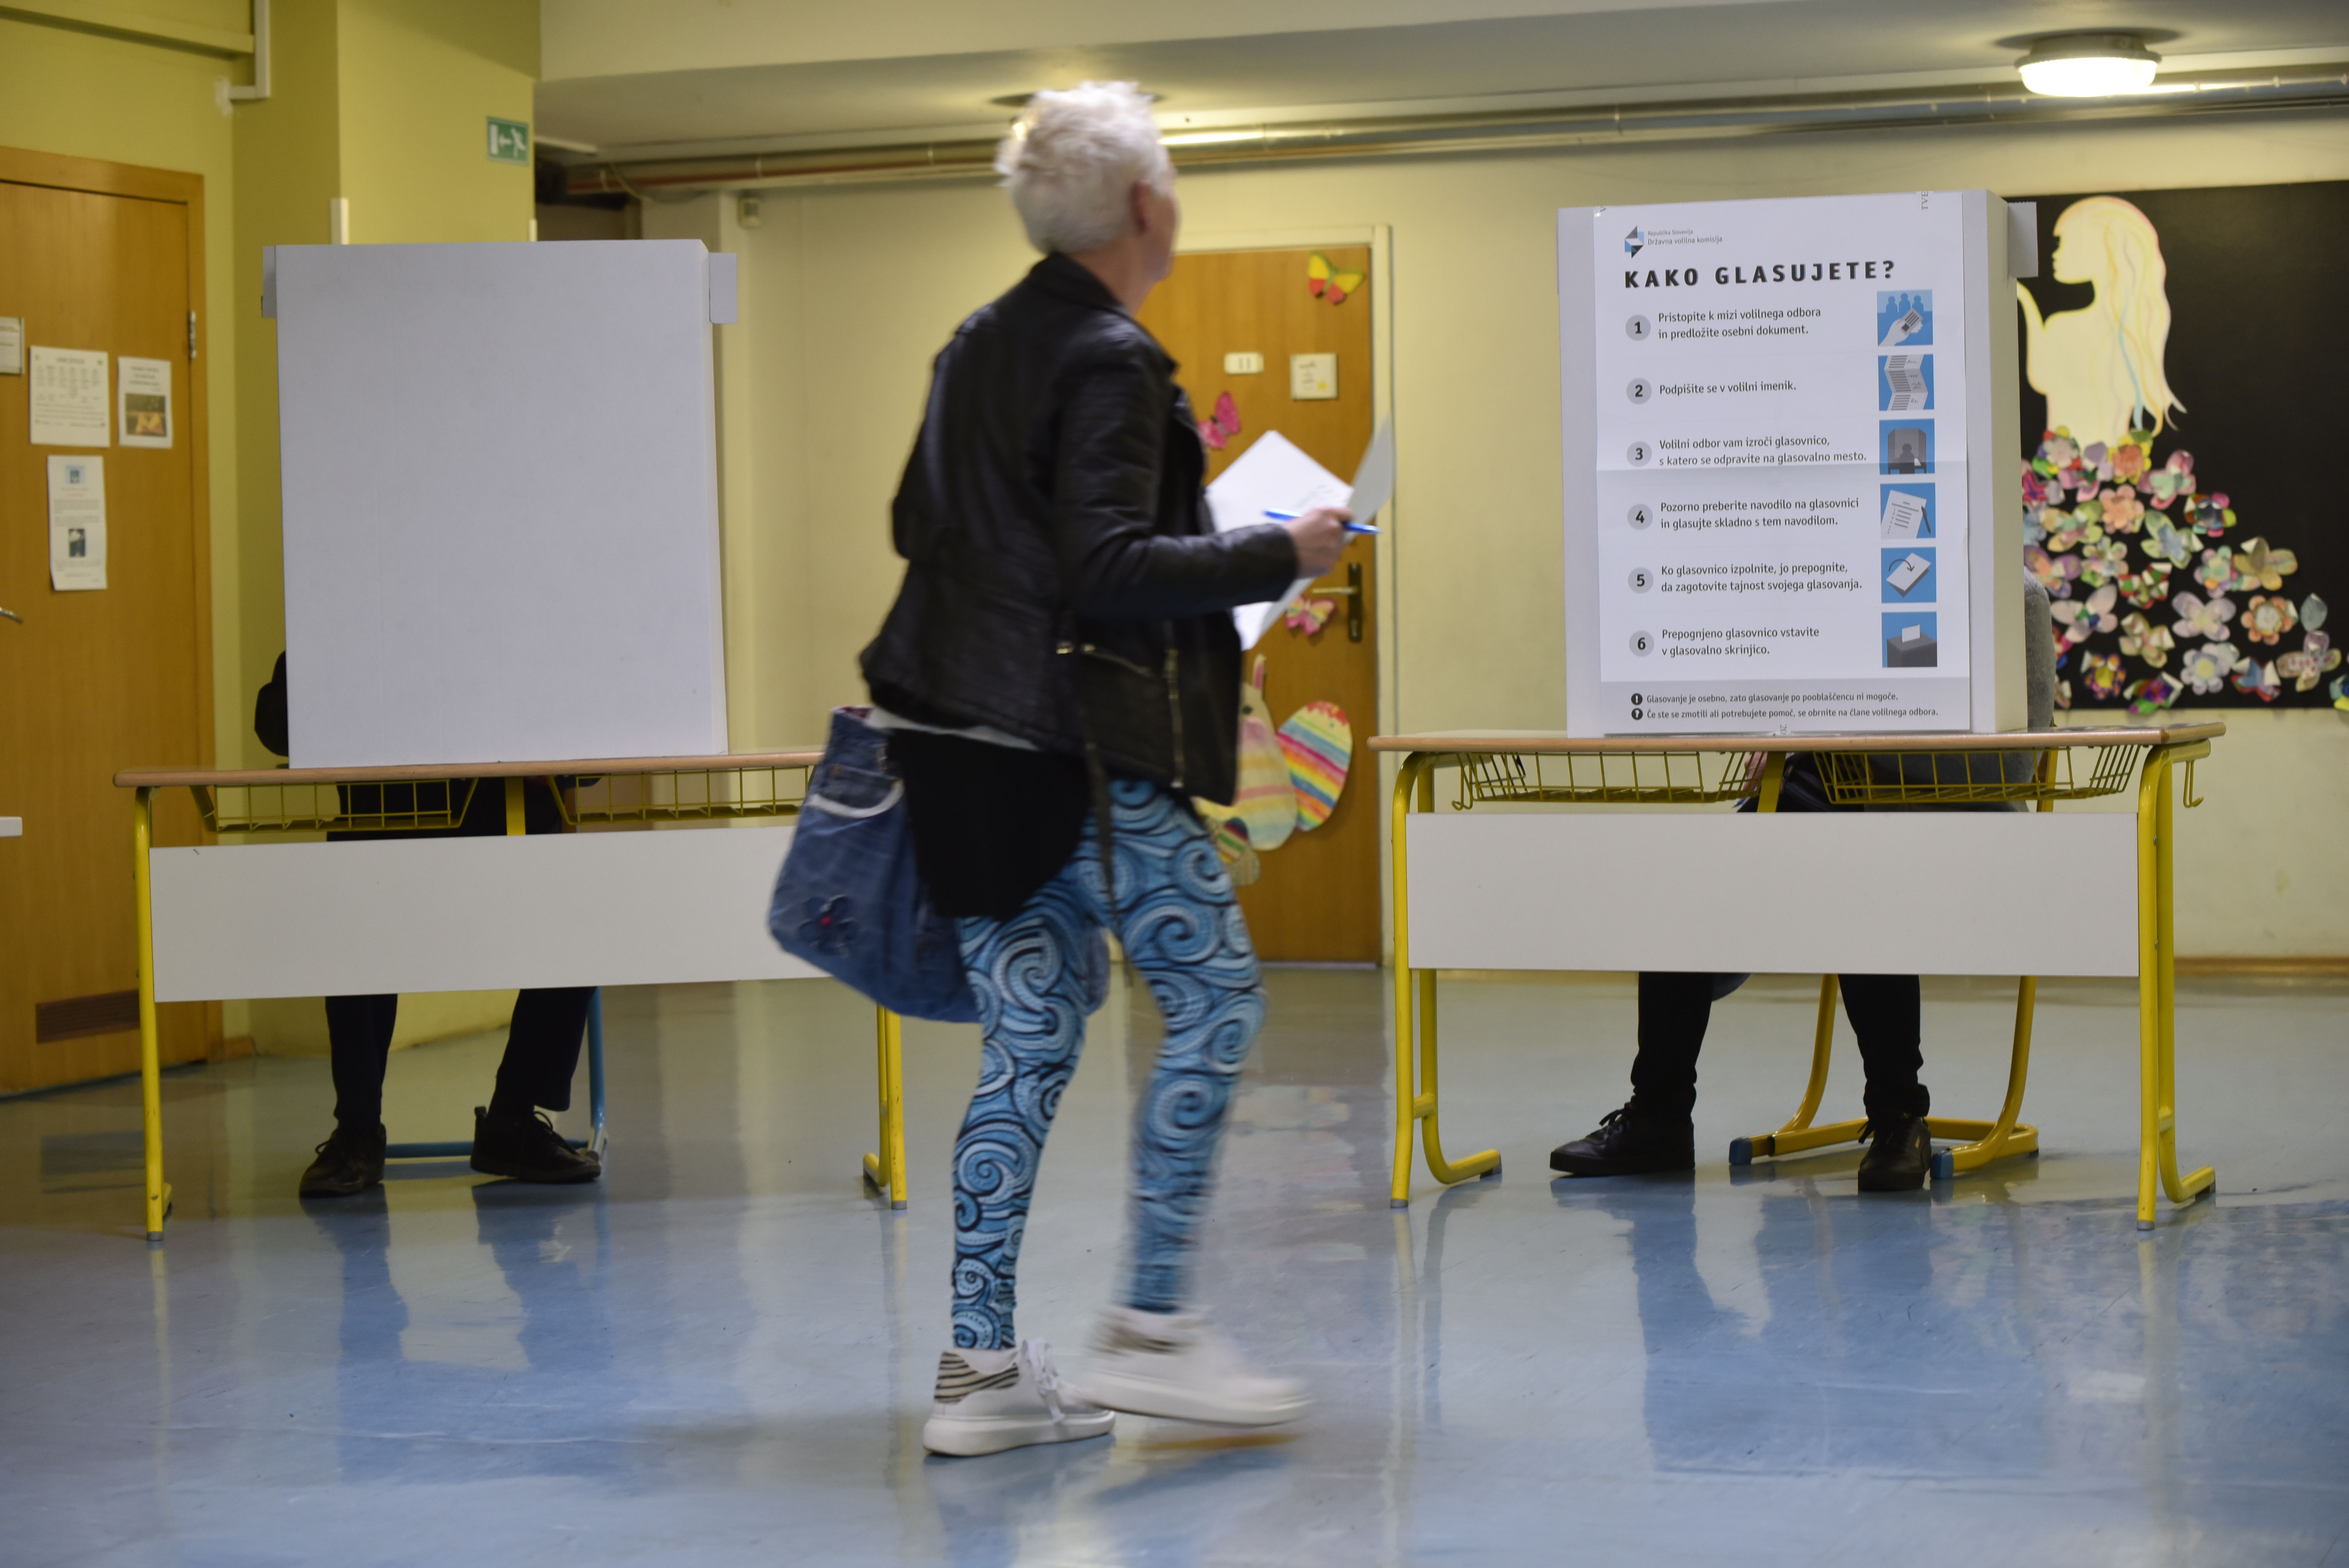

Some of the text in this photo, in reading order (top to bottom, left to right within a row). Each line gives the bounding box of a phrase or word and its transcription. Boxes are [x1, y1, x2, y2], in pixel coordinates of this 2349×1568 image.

[1648, 236, 1672, 246] Državna
[1697, 235, 1723, 244] komisija
[1625, 260, 1895, 289] KAKO GLASUJETE?
[1659, 306, 1821, 325] Pristopite k mizi volilnega odbora
[1634, 321, 1642, 335] 1
[1658, 324, 1809, 342] in predložite osebni dokument.
[1635, 384, 1643, 398] 2
[1660, 383, 1704, 397] Podpišite
[1707, 385, 1717, 393] se
[1727, 381, 1757, 393] volilni
[1760, 380, 1797, 392] imenik.
[1659, 435, 1830, 450] Volilni odbor vam izroči glasovnico,
[1635, 447, 1643, 461] 3
[1667, 455, 1698, 466] katero
[1714, 453, 1760, 467] odpravite
[1763, 455, 1775, 463] na
[1777, 451, 1830, 465] glasovalno
[1834, 451, 1867, 461] mesto.
[1661, 497, 1859, 514] Pozorno preberite navodilo na glasovnici
[1635, 510, 1645, 524] 4
[1660, 515, 1838, 531] in glasujte skladno s tem navodilom.
[1661, 561, 1848, 578] Ko glasovnico izpolnite, jo prepognite,
[1636, 574, 1645, 587] 5
[1661, 578, 1862, 594] da zagotovite tajnost svojega glasovanja.
[1662, 626, 1819, 642] Prepognjeno glasovnico vstavite
[1637, 637, 1646, 651] 6
[1662, 643, 1770, 658] v glasovalno skrinjico.
[1647, 694, 1687, 705] Glasovanje
[1688, 694, 1696, 705] je
[1698, 693, 1727, 703] osebno,
[1729, 694, 1747, 702] zato
[1748, 693, 1789, 704] glasovanje
[1791, 695, 1800, 704] po
[1802, 692, 1854, 703] pooblaščencu
[1856, 691, 1864, 701] ni
[1866, 691, 1898, 702] mogoče.
[1647, 708, 1656, 719] Če
[1657, 711, 1669, 719] ste
[1681, 709, 1707, 718] zmotili
[1709, 709, 1719, 718] ali
[1721, 709, 1767, 720] potrebujete
[1769, 709, 1796, 719] pomoč,
[1808, 708, 1836, 717] obrnite
[1850, 707, 1870, 717] člane
[1871, 707, 1907, 718] volilnega
[1909, 707, 1938, 716] odbora.
